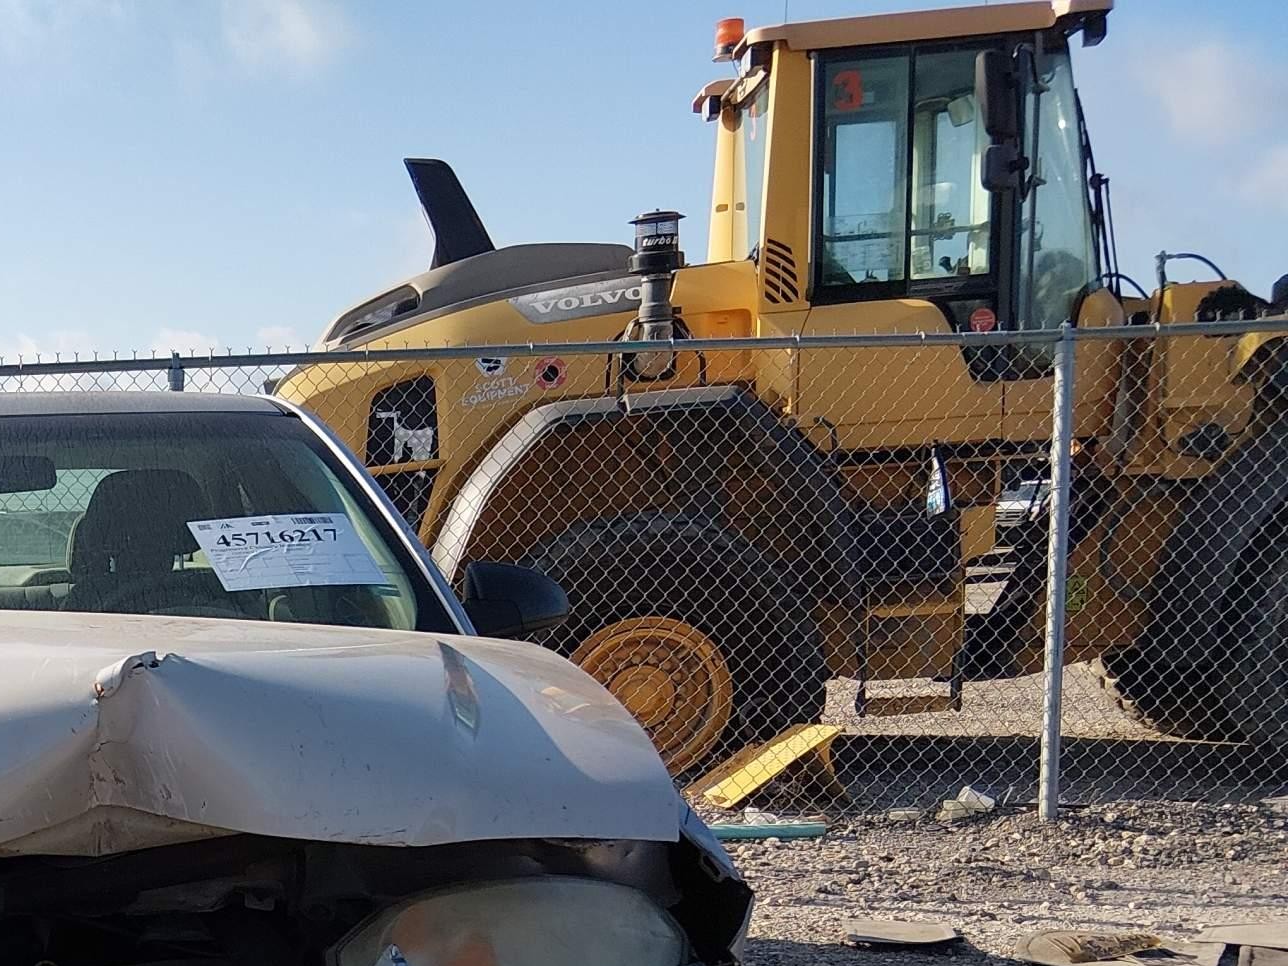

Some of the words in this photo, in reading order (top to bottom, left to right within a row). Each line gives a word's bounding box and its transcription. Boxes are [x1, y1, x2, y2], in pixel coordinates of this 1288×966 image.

[833, 70, 863, 111] 3
[642, 235, 671, 247] turbo
[530, 286, 642, 314] VOLVO
[462, 383, 530, 406] EQUIPMENT
[475, 377, 514, 393] SCOTT
[216, 528, 337, 547] 45716217
